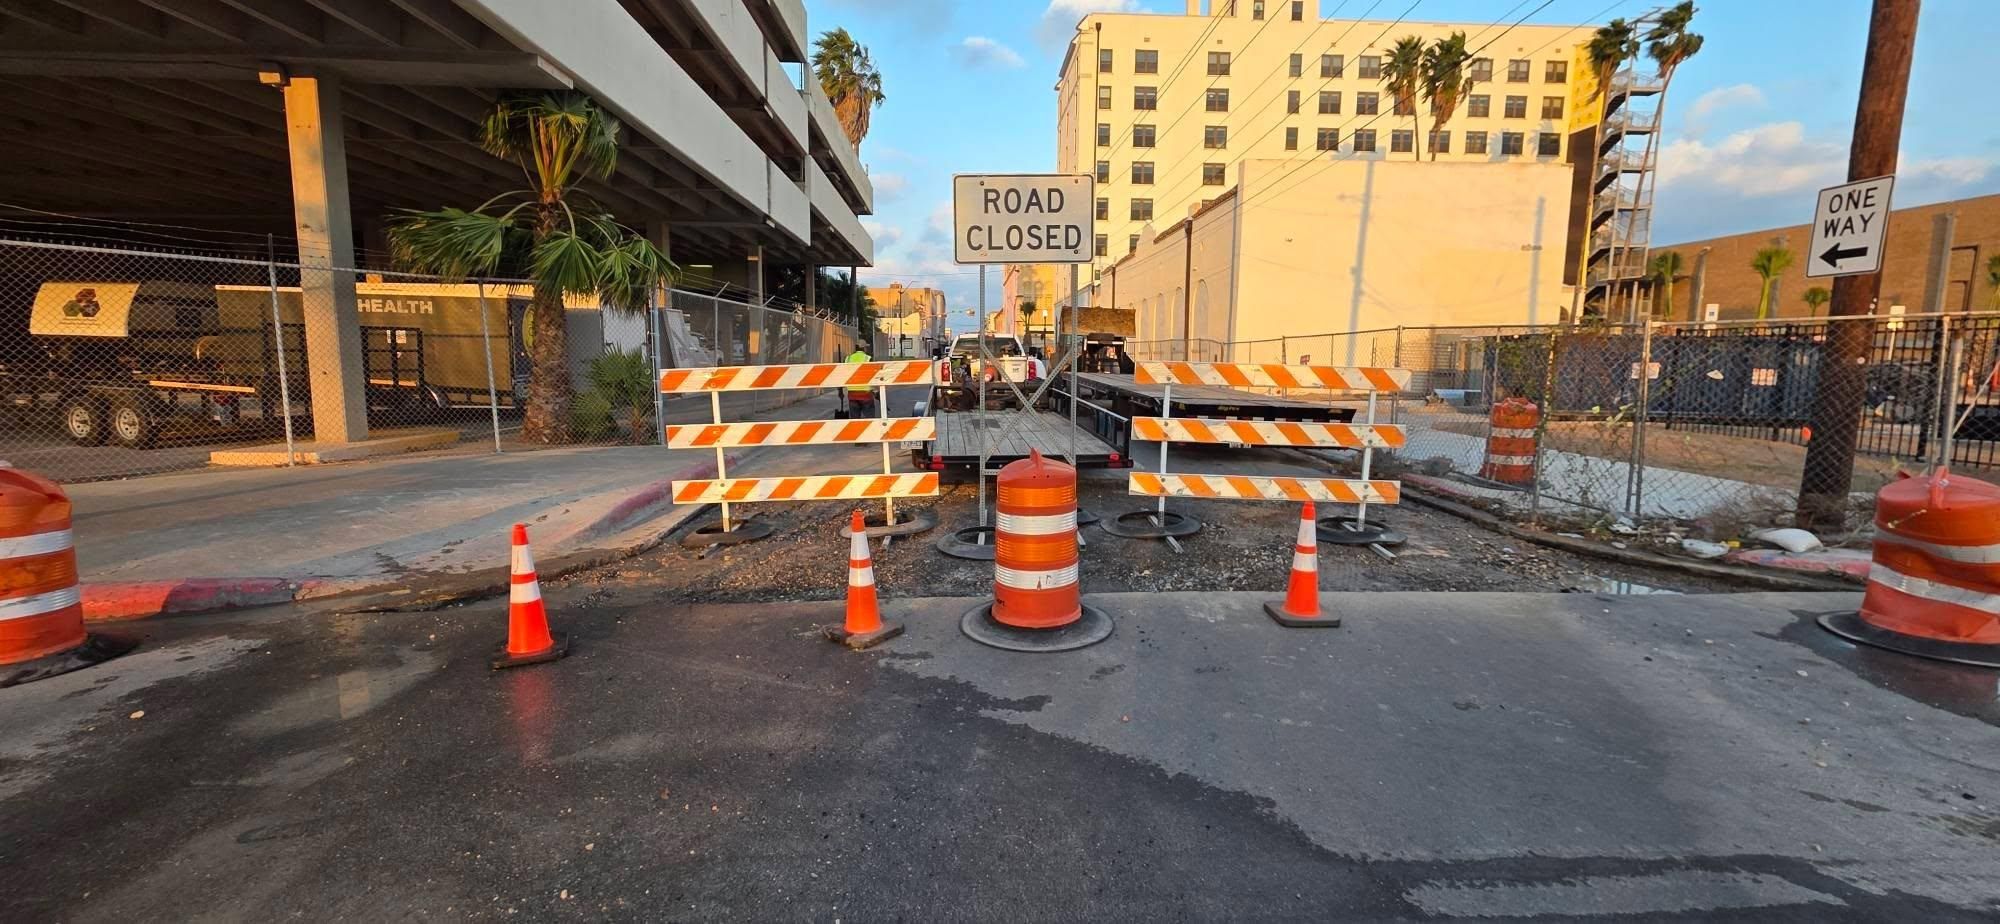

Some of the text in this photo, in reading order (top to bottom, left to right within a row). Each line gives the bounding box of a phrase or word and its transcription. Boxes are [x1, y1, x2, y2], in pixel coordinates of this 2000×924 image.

[983, 188, 1065, 214] ROAD
[1829, 187, 1878, 214] ONE
[966, 224, 1082, 251] CLOSED
[1824, 212, 1876, 238] WAY
[357, 299, 433, 314] HEALTH
